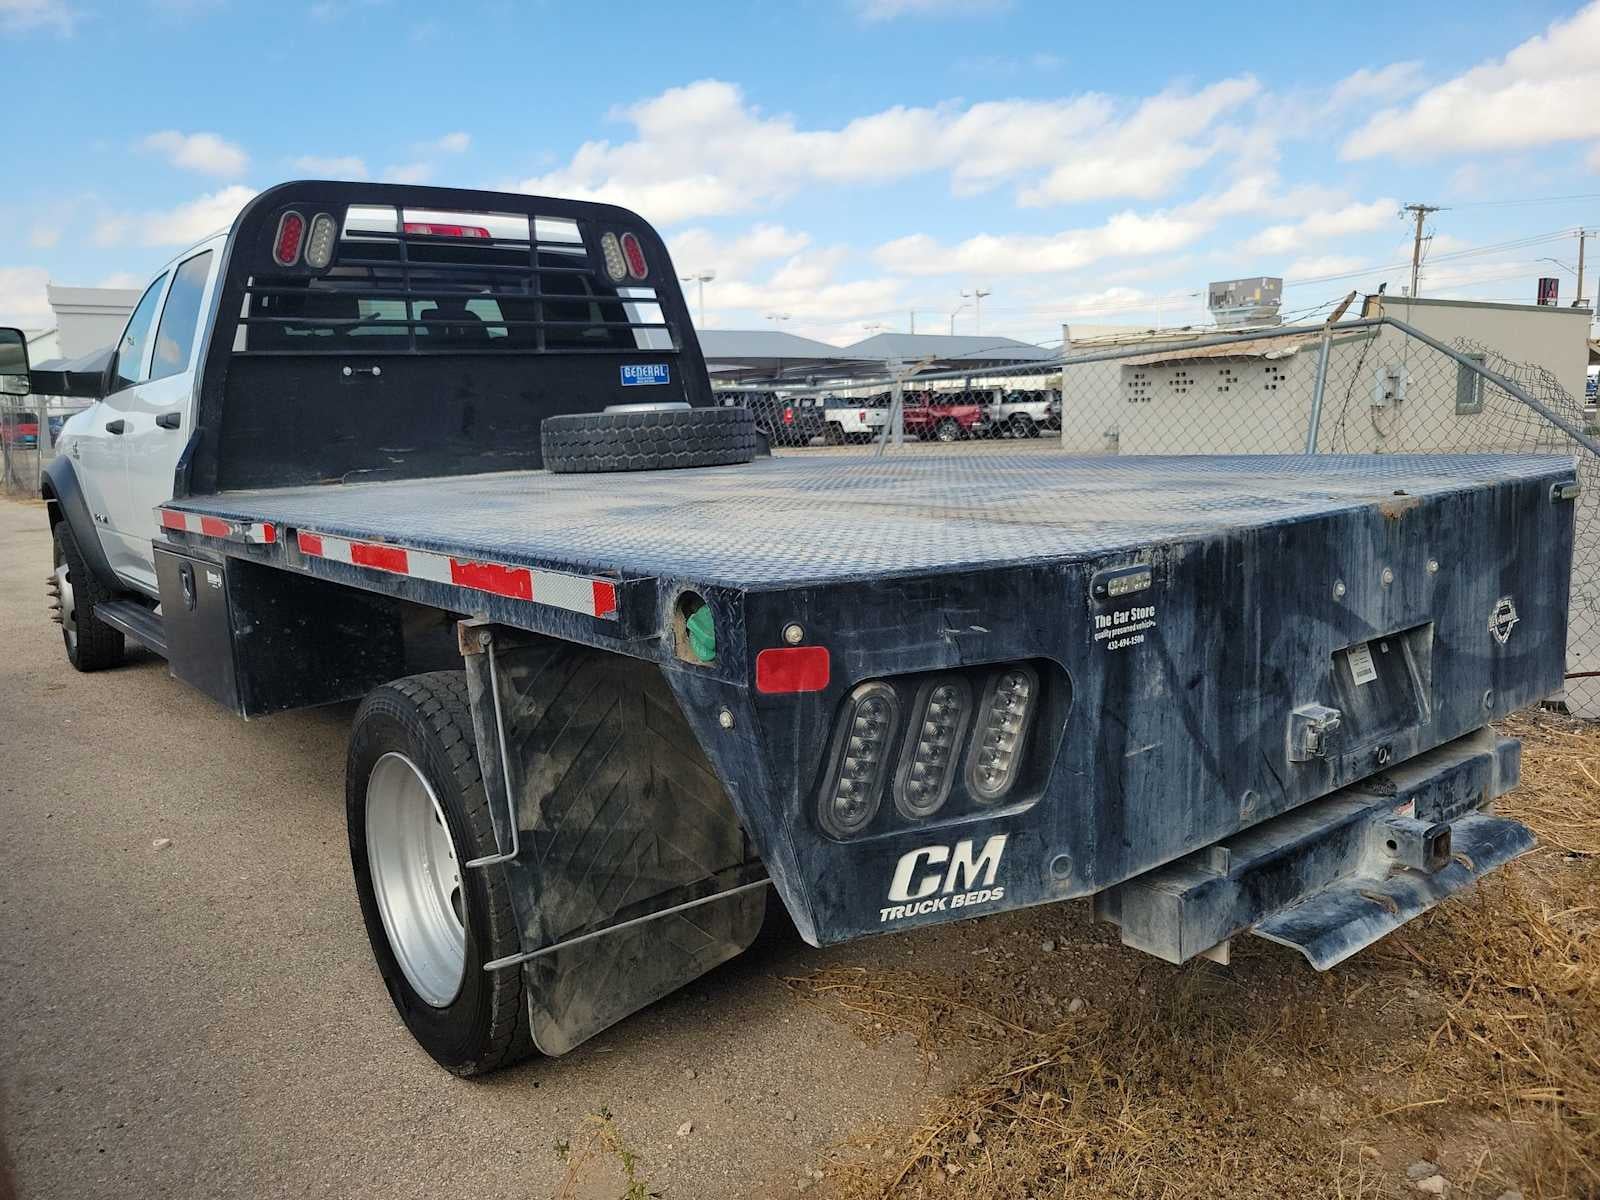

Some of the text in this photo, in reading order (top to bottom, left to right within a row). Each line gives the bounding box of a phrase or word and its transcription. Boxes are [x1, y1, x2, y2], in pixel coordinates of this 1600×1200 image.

[624, 365, 665, 377] GENERAL
[1095, 606, 1156, 629] The Car Store
[888, 833, 1009, 901] CM
[879, 887, 1005, 922] TRUCK BEDS
